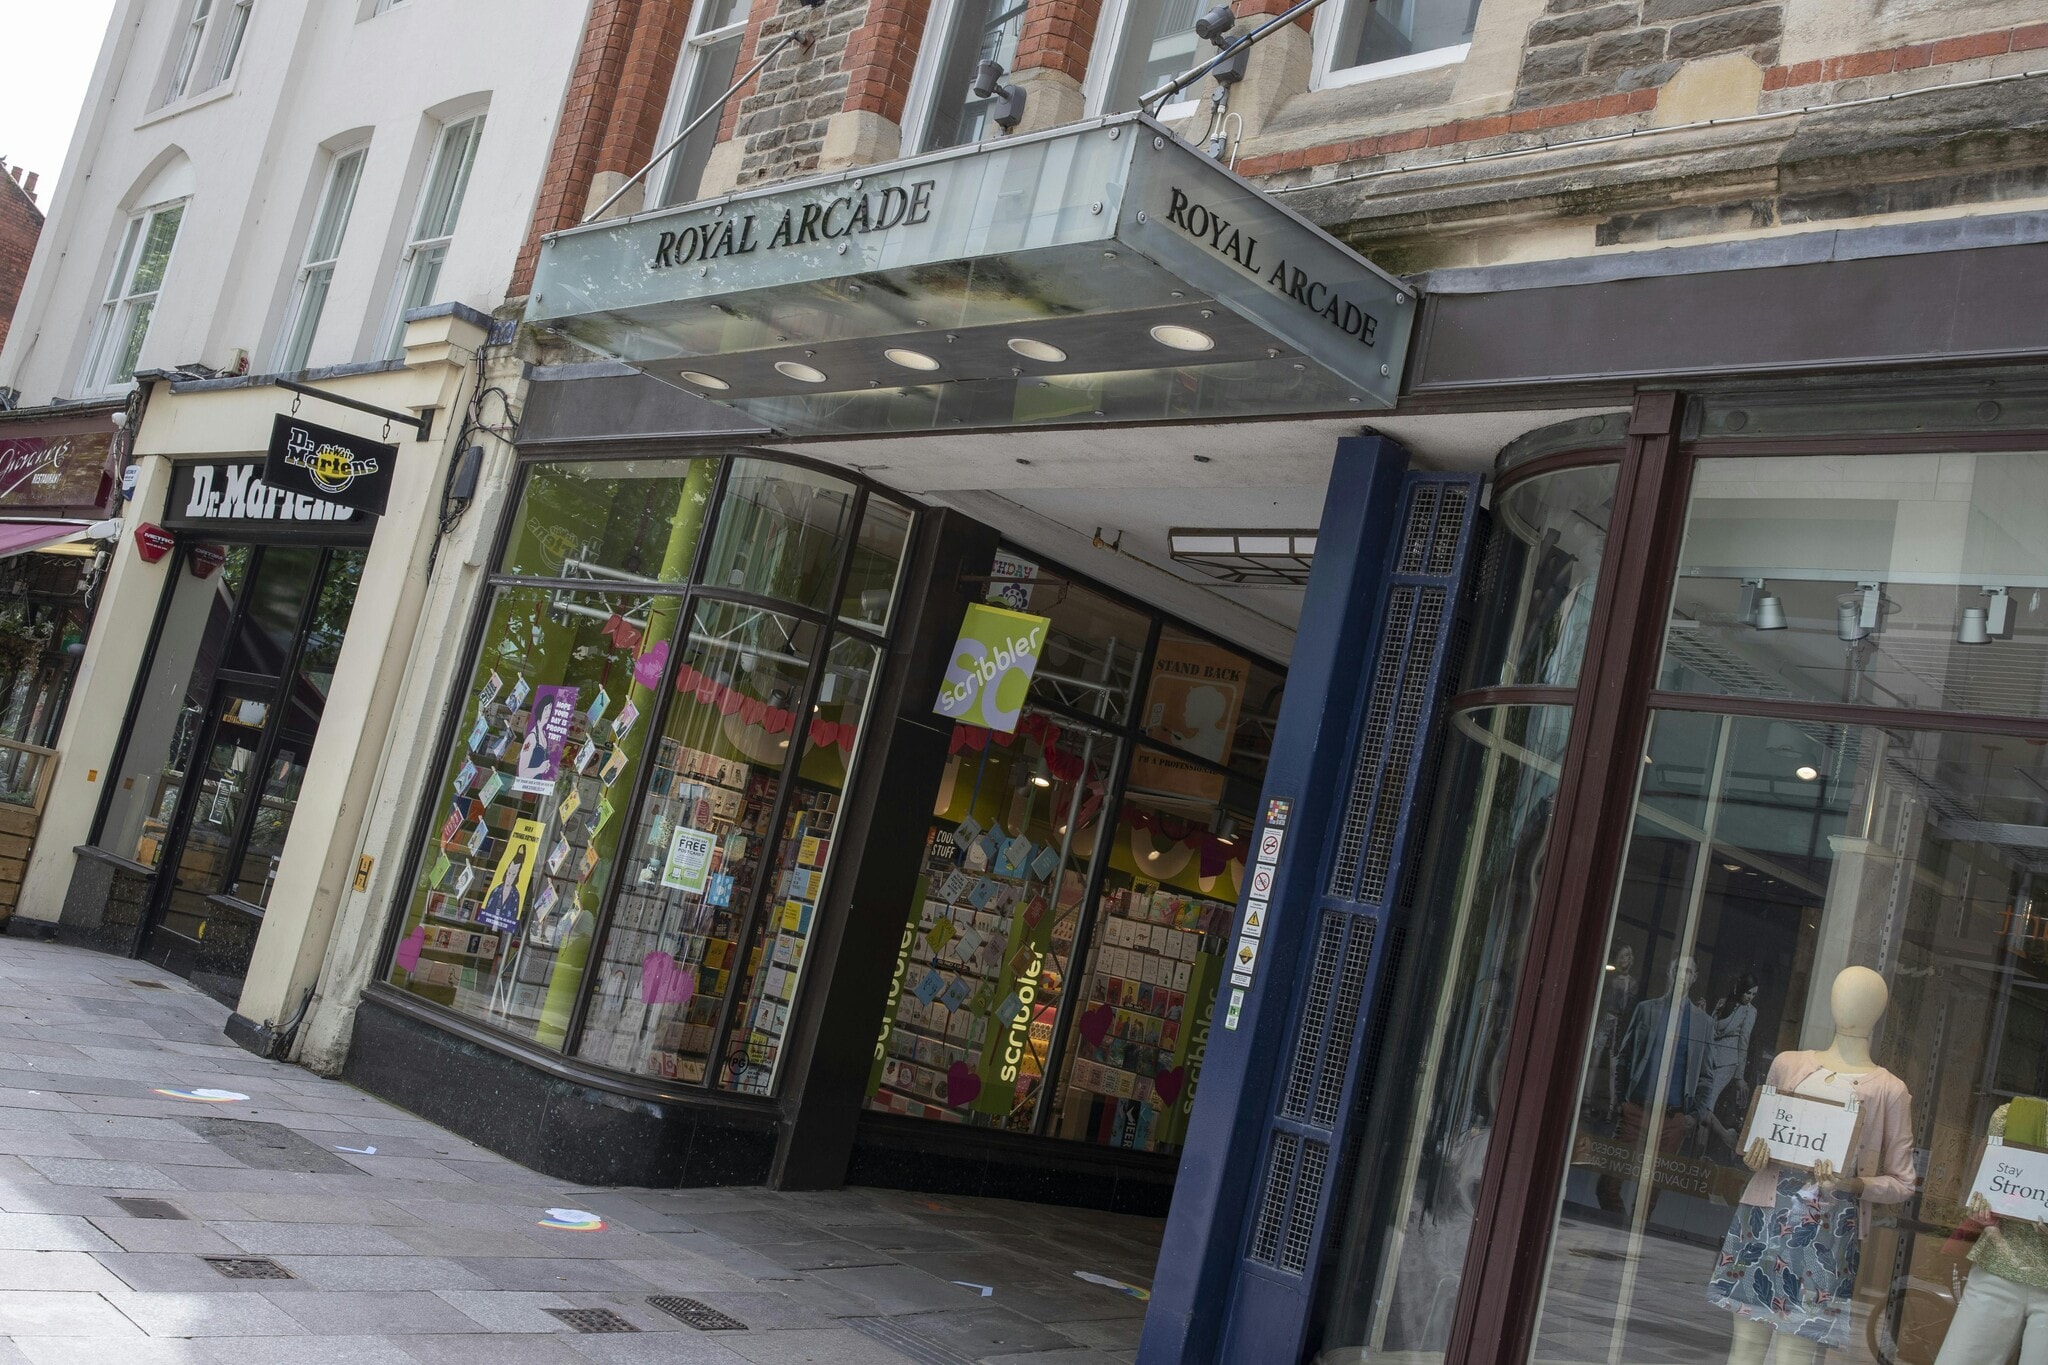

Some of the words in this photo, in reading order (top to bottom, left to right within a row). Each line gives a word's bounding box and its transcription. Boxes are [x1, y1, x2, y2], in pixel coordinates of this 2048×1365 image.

[651, 215, 757, 269] ROYAL
[767, 179, 935, 250] ARCADE
[1166, 186, 1260, 275] ROYAL
[1267, 259, 1379, 349] ARCADE
[288, 427, 315, 451] Dr.
[285, 445, 379, 477] Martens
[31, 473, 61, 484] RESTAURANT
[144, 532, 174, 544] METRO
[941, 627, 1040, 711] scribbler
[1156, 659, 1200, 676] STAND
[1204, 666, 1242, 682] BACK
[556, 701, 572, 711] HOPE
[554, 709, 569, 719] YOUR
[546, 724, 568, 735] PROPER
[679, 839, 706, 853] FREE
[931, 844, 956, 859] STUFF
[732, 1058, 747, 1068] PG
[1775, 1108, 1793, 1123] Be
[1768, 1123, 1828, 1152] Kind
[1996, 1162, 2024, 1178] Stay
